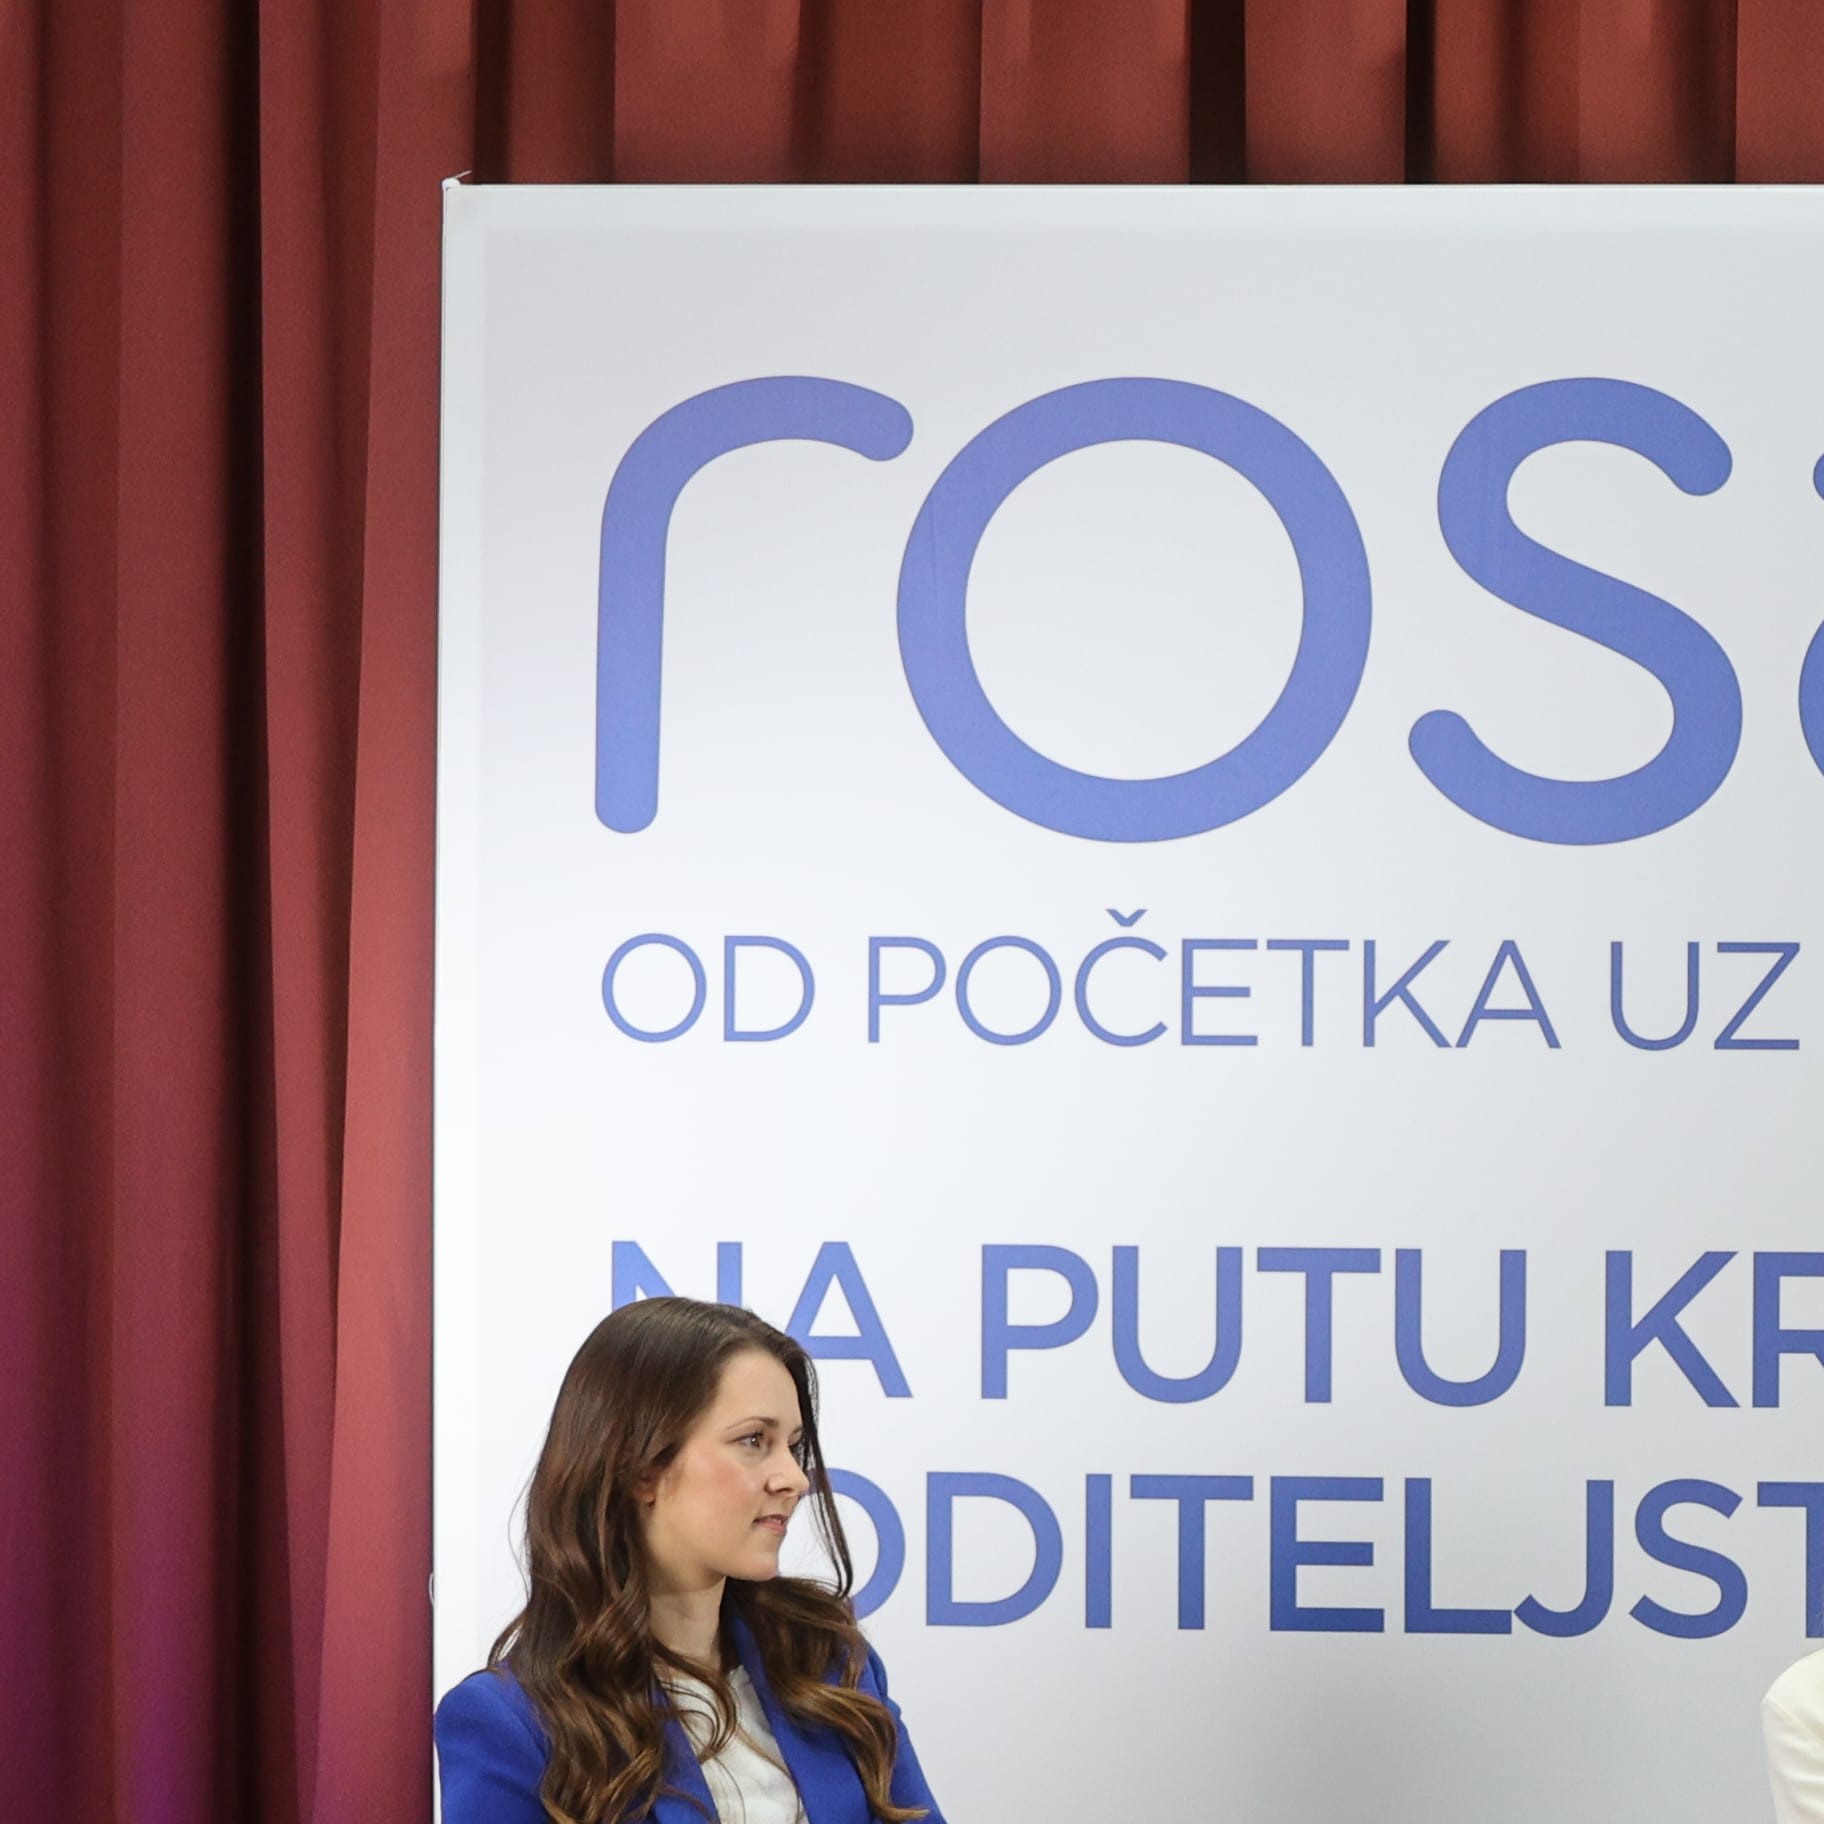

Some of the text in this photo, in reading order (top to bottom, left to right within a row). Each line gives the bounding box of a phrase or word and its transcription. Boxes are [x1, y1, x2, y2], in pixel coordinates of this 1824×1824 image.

[601, 932, 815, 1044] OD
[868, 908, 1561, 1050] POČETKA
[1610, 941, 1801, 1052] UZ
[982, 1245, 1527, 1409] PUTU
